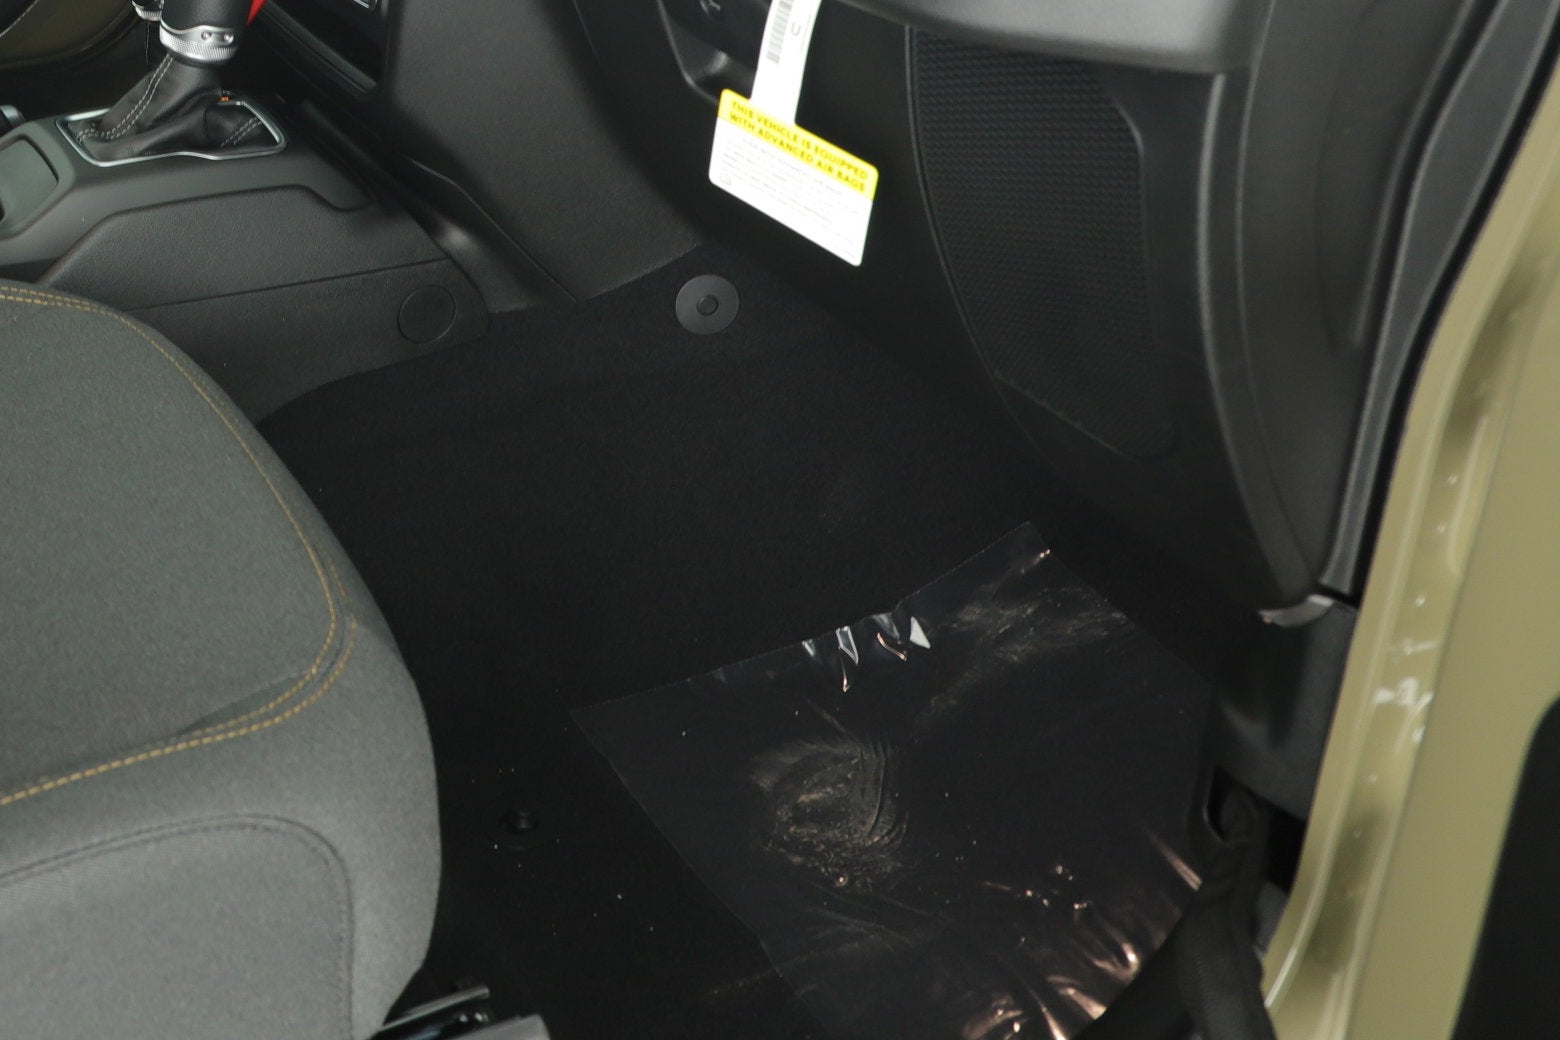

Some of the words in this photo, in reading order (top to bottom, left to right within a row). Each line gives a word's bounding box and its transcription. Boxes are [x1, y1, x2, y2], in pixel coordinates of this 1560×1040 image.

[729, 112, 755, 132] WITH
[757, 127, 814, 164] ADVANCED
[816, 159, 834, 175] AIR
[836, 170, 865, 192] BAGS
[732, 101, 754, 119] THIS
[756, 114, 798, 143] VEHICLE
[801, 138, 812, 151] IS
[814, 145, 868, 181] EQUIPPED
